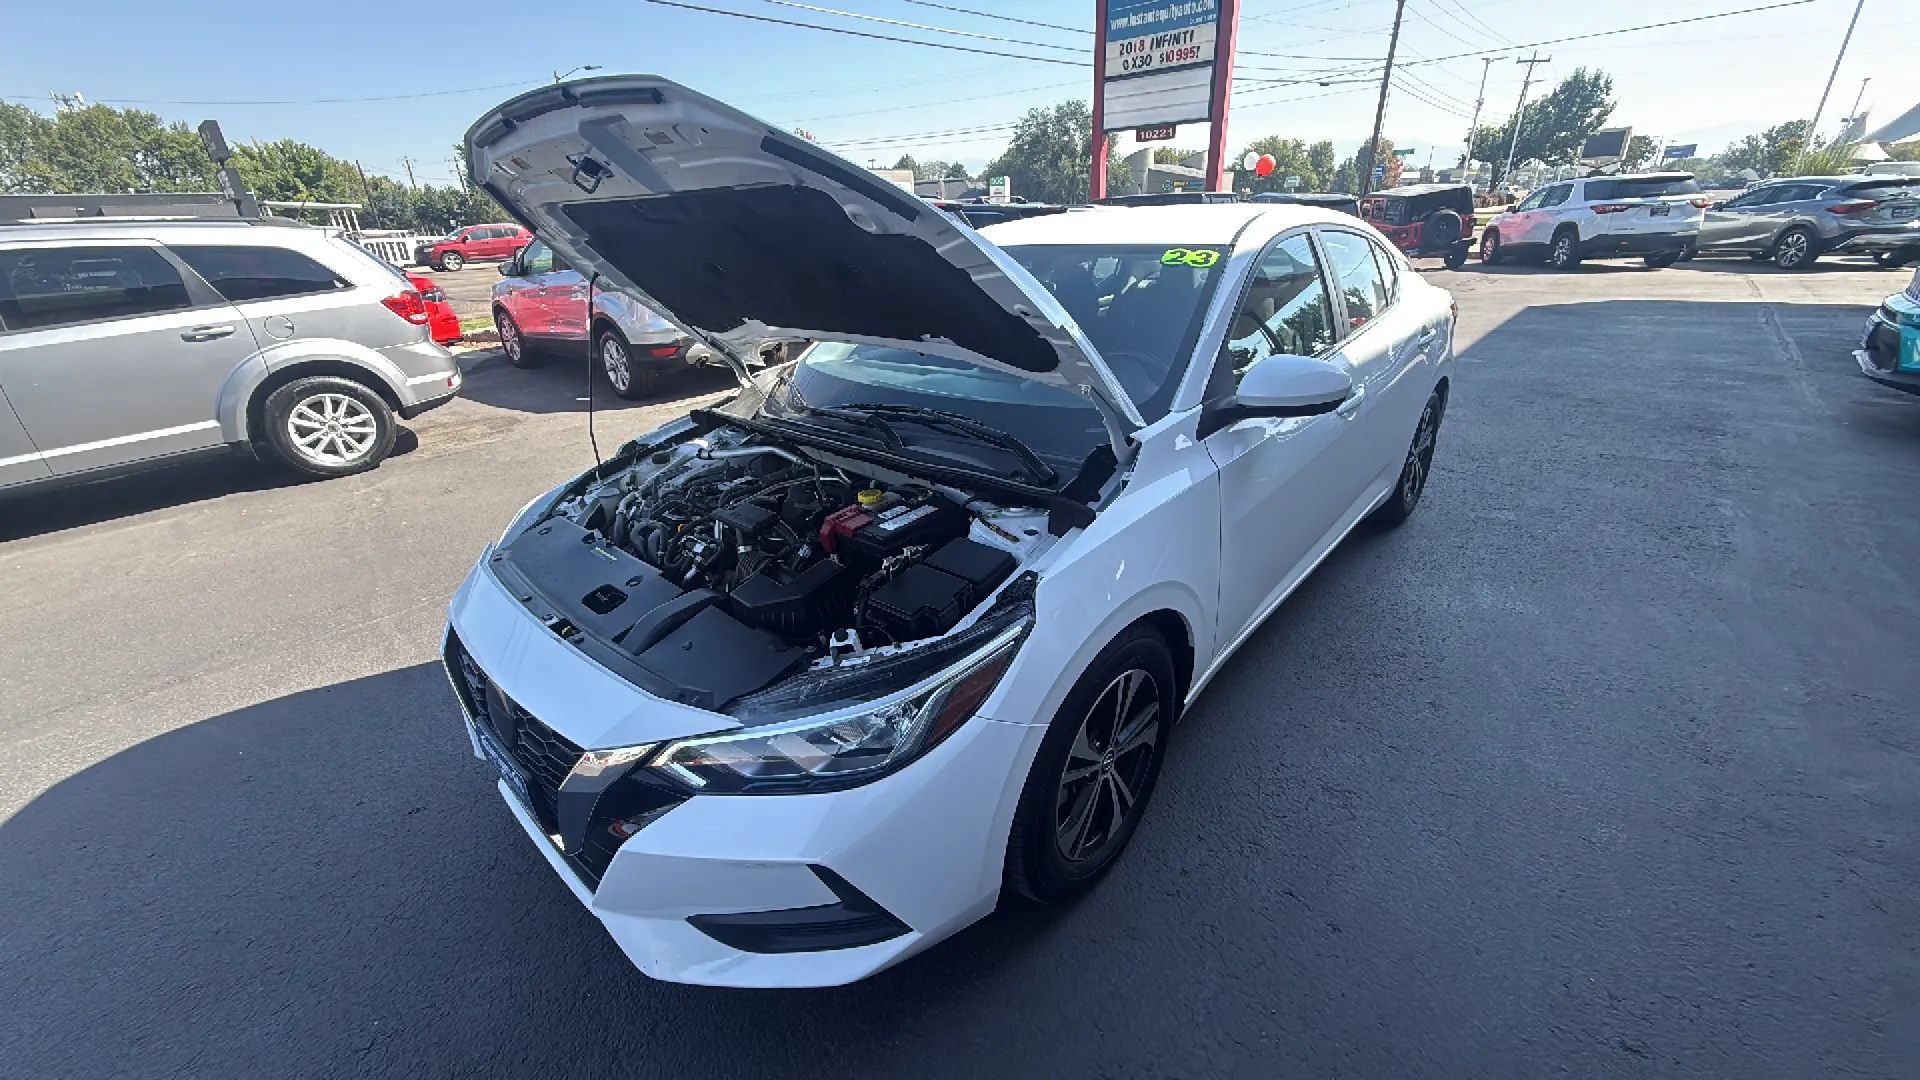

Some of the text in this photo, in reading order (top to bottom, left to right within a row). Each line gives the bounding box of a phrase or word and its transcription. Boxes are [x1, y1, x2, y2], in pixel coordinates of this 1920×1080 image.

[1119, 39, 1145, 57] 2018
[1139, 127, 1173, 140] 10221
[1163, 249, 1219, 267] 23
